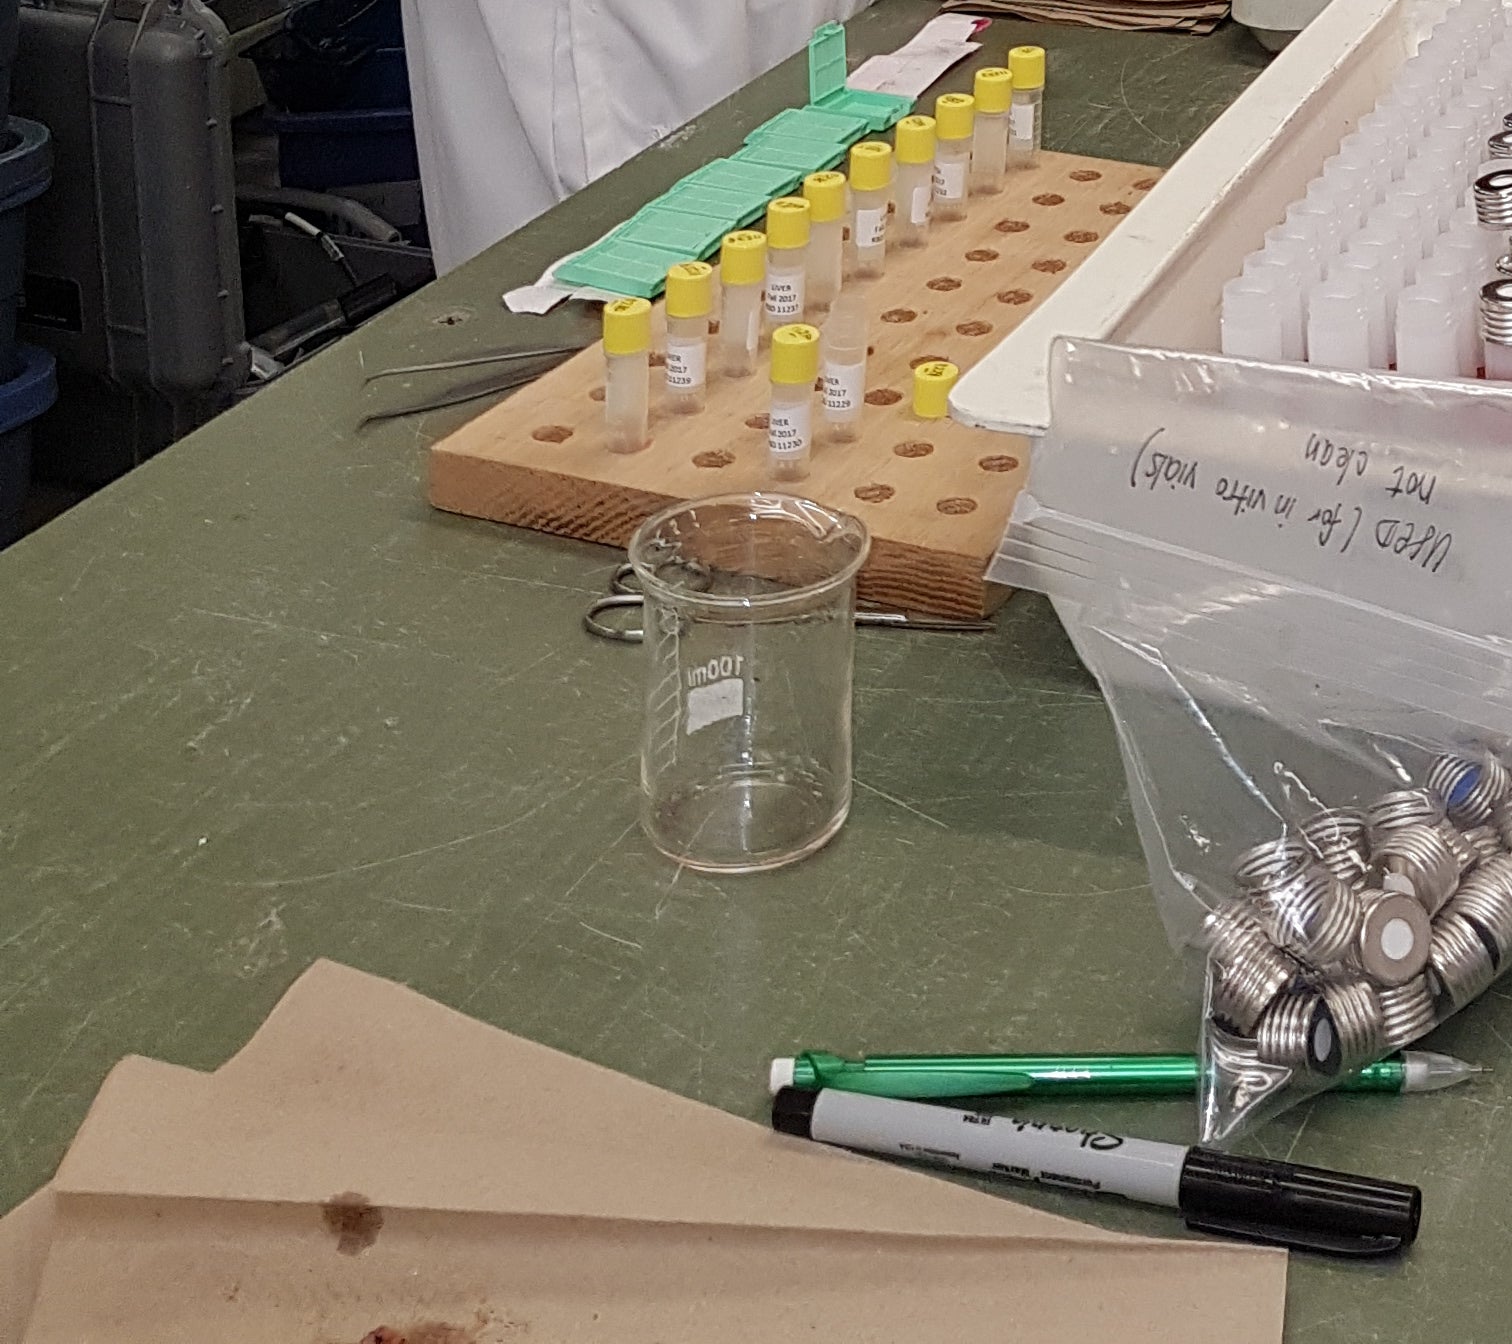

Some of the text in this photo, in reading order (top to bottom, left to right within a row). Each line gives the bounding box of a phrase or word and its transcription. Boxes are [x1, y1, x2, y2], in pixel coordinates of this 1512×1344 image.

[1305, 433, 1437, 505] not clean
[1214, 478, 1266, 516] vitro
[1275, 494, 1297, 529] in
